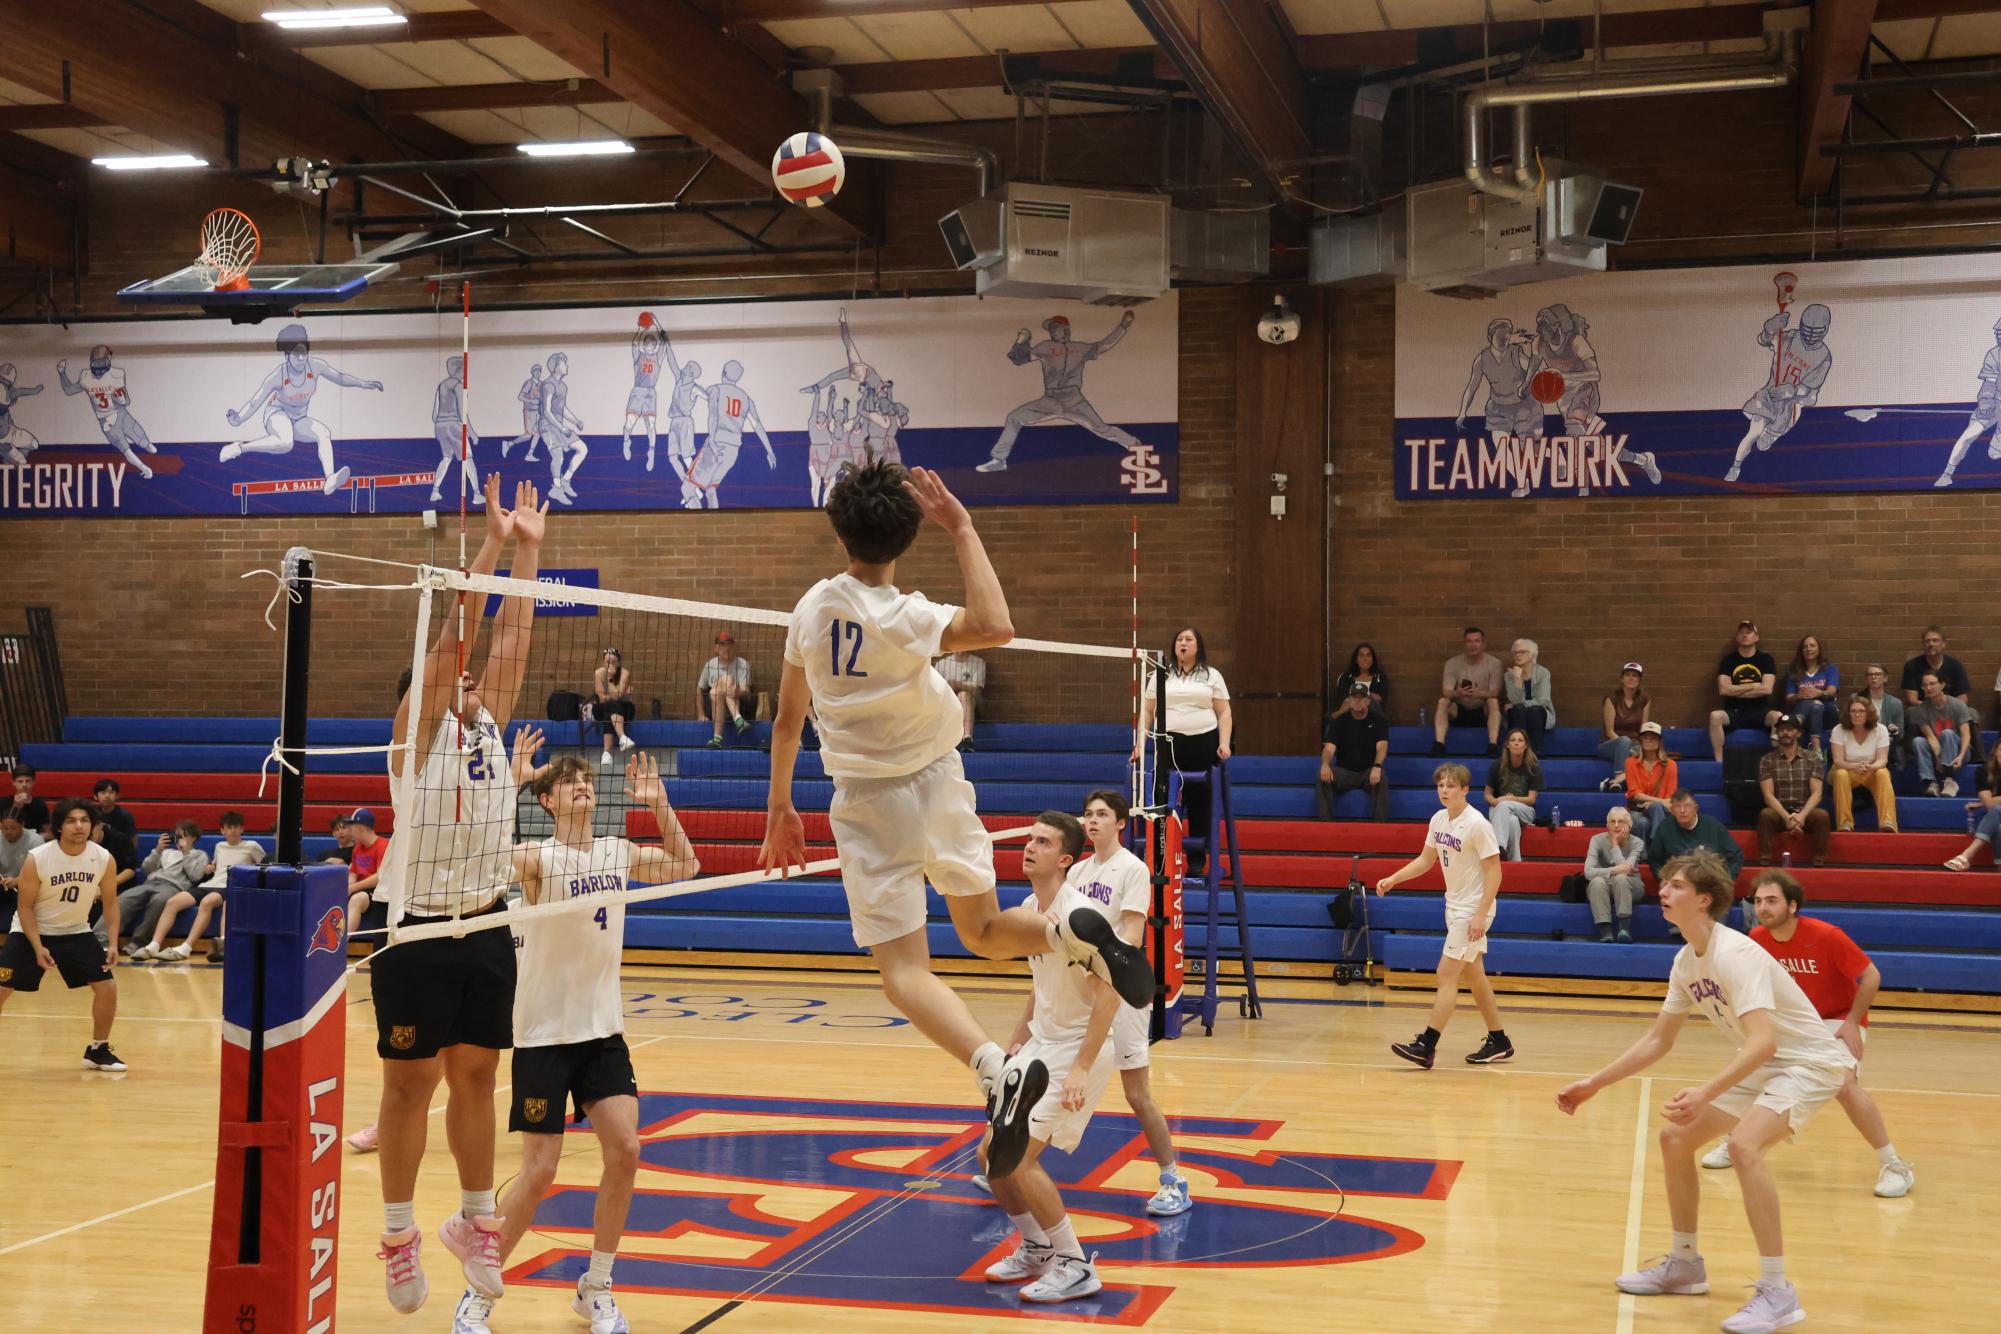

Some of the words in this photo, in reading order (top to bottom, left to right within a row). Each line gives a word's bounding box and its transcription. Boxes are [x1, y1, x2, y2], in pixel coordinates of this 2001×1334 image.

[725, 395, 742, 418] 10
[1405, 433, 1631, 491] TEAMWORK
[0, 463, 126, 508] TEGRITY
[275, 482, 289, 492] LA
[831, 618, 868, 677] 12
[1442, 850, 1449, 867] 6
[50, 871, 95, 887] BARLOW
[569, 874, 623, 898] BARLOW
[1173, 852, 1184, 931] SALLE
[59, 886, 80, 903] 10
[593, 906, 608, 931] 4
[1174, 943, 1185, 970] LA
[307, 1076, 338, 1164] LA
